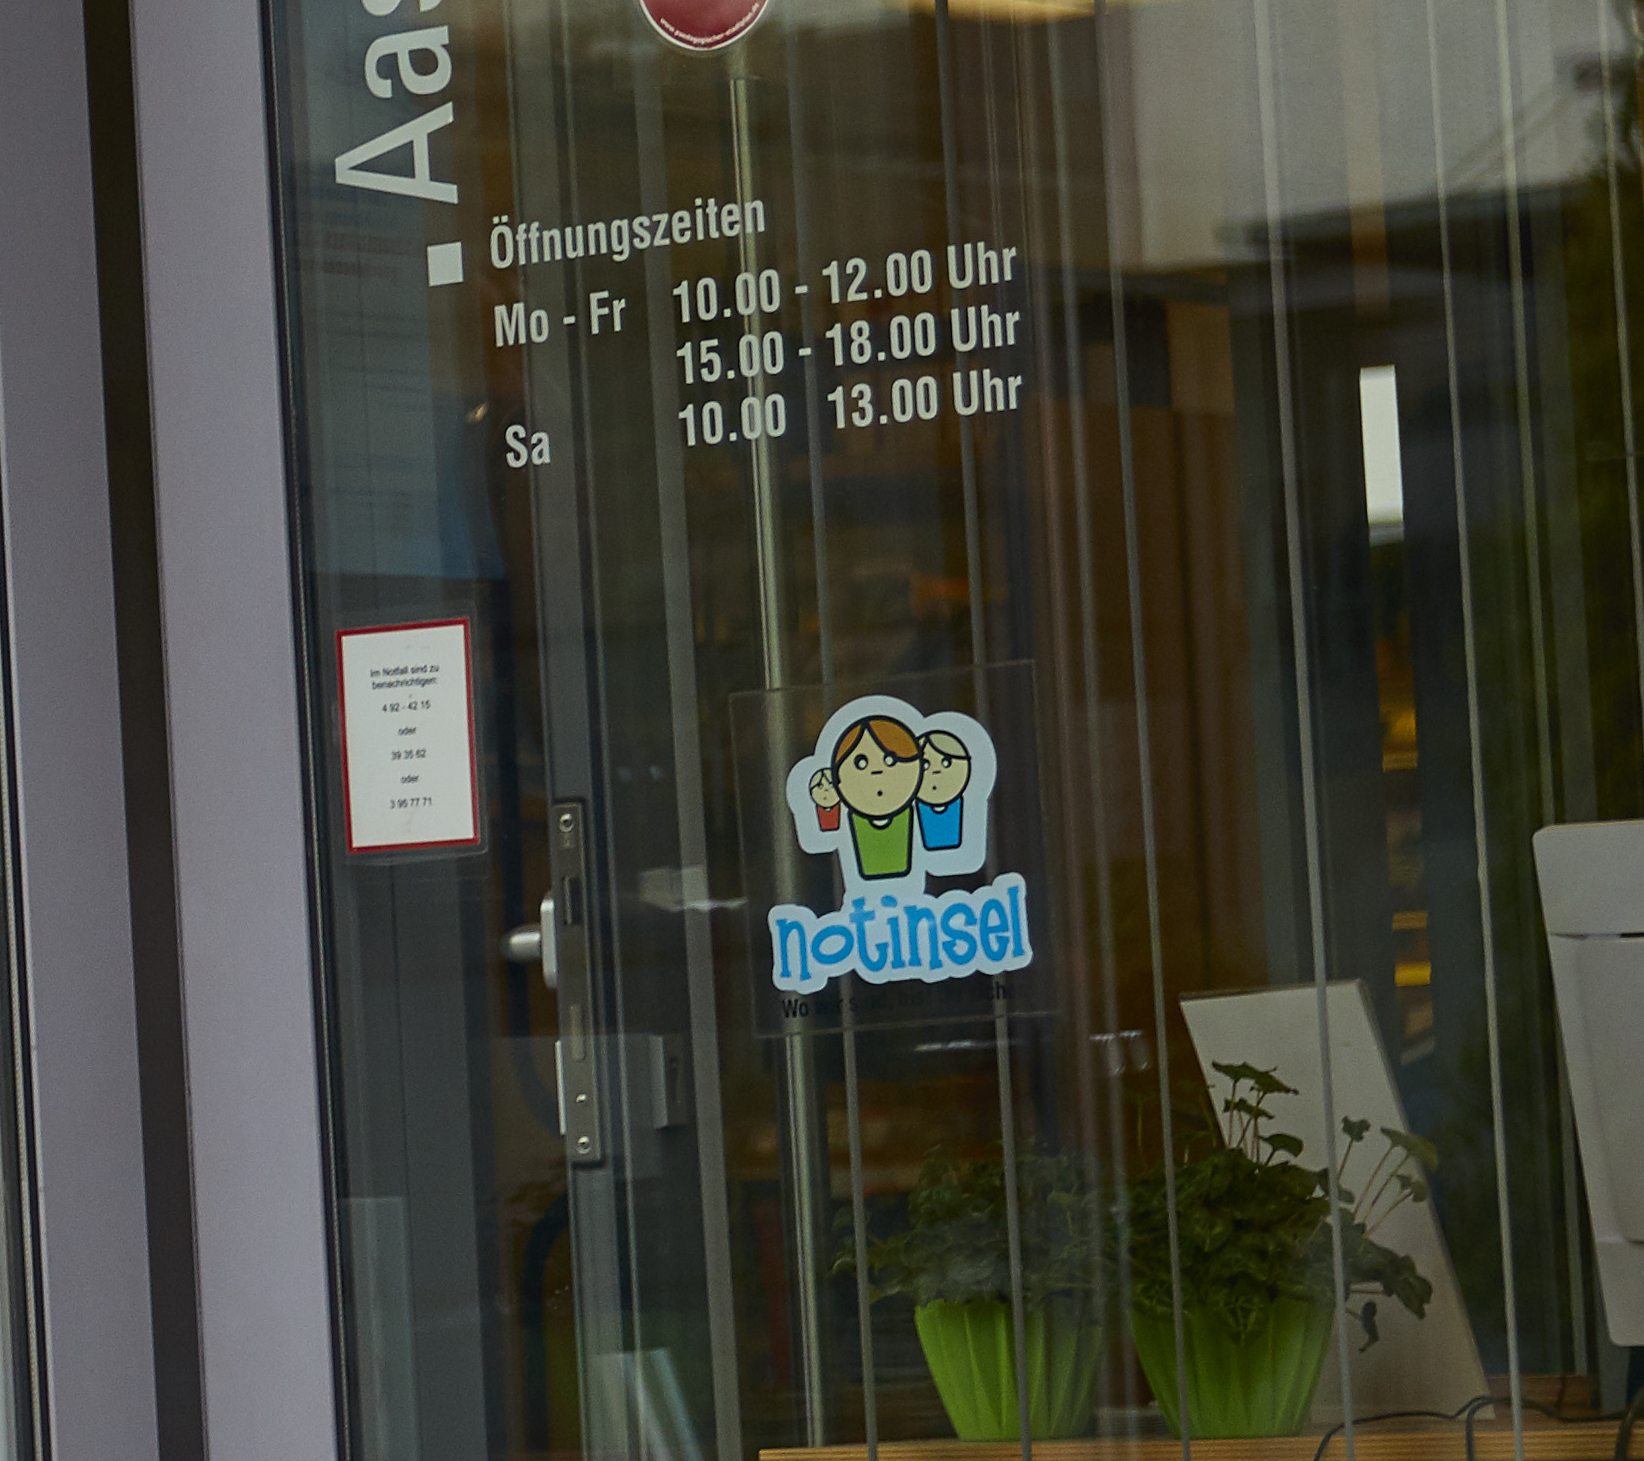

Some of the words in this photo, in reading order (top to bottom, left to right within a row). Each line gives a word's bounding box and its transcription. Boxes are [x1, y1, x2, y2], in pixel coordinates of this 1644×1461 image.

[489, 196, 766, 269] Öffnungszeiten
[493, 301, 549, 347] Mo
[589, 290, 626, 334] Fr
[672, 268, 781, 323] 10.00
[821, 249, 933, 304] 12.00
[947, 241, 1017, 290] Uhr
[676, 330, 785, 385] 15.00
[825, 312, 937, 367] 18.00
[950, 304, 1021, 352] Uhr
[504, 424, 551, 469] Sa
[678, 393, 787, 447] 10.00
[827, 374, 938, 430] 13.00
[952, 368, 1023, 417] Uhr
[370, 668, 381, 677] Im
[382, 665, 409, 676] Notfall
[429, 664, 440, 673] zu
[390, 702, 400, 712] 92
[407, 701, 418, 711] 42
[398, 725, 416, 736] oder
[401, 774, 419, 784] oder
[422, 797, 432, 806] 71
[776, 885, 1025, 981] notinsel
[782, 999, 809, 1019] Wo
